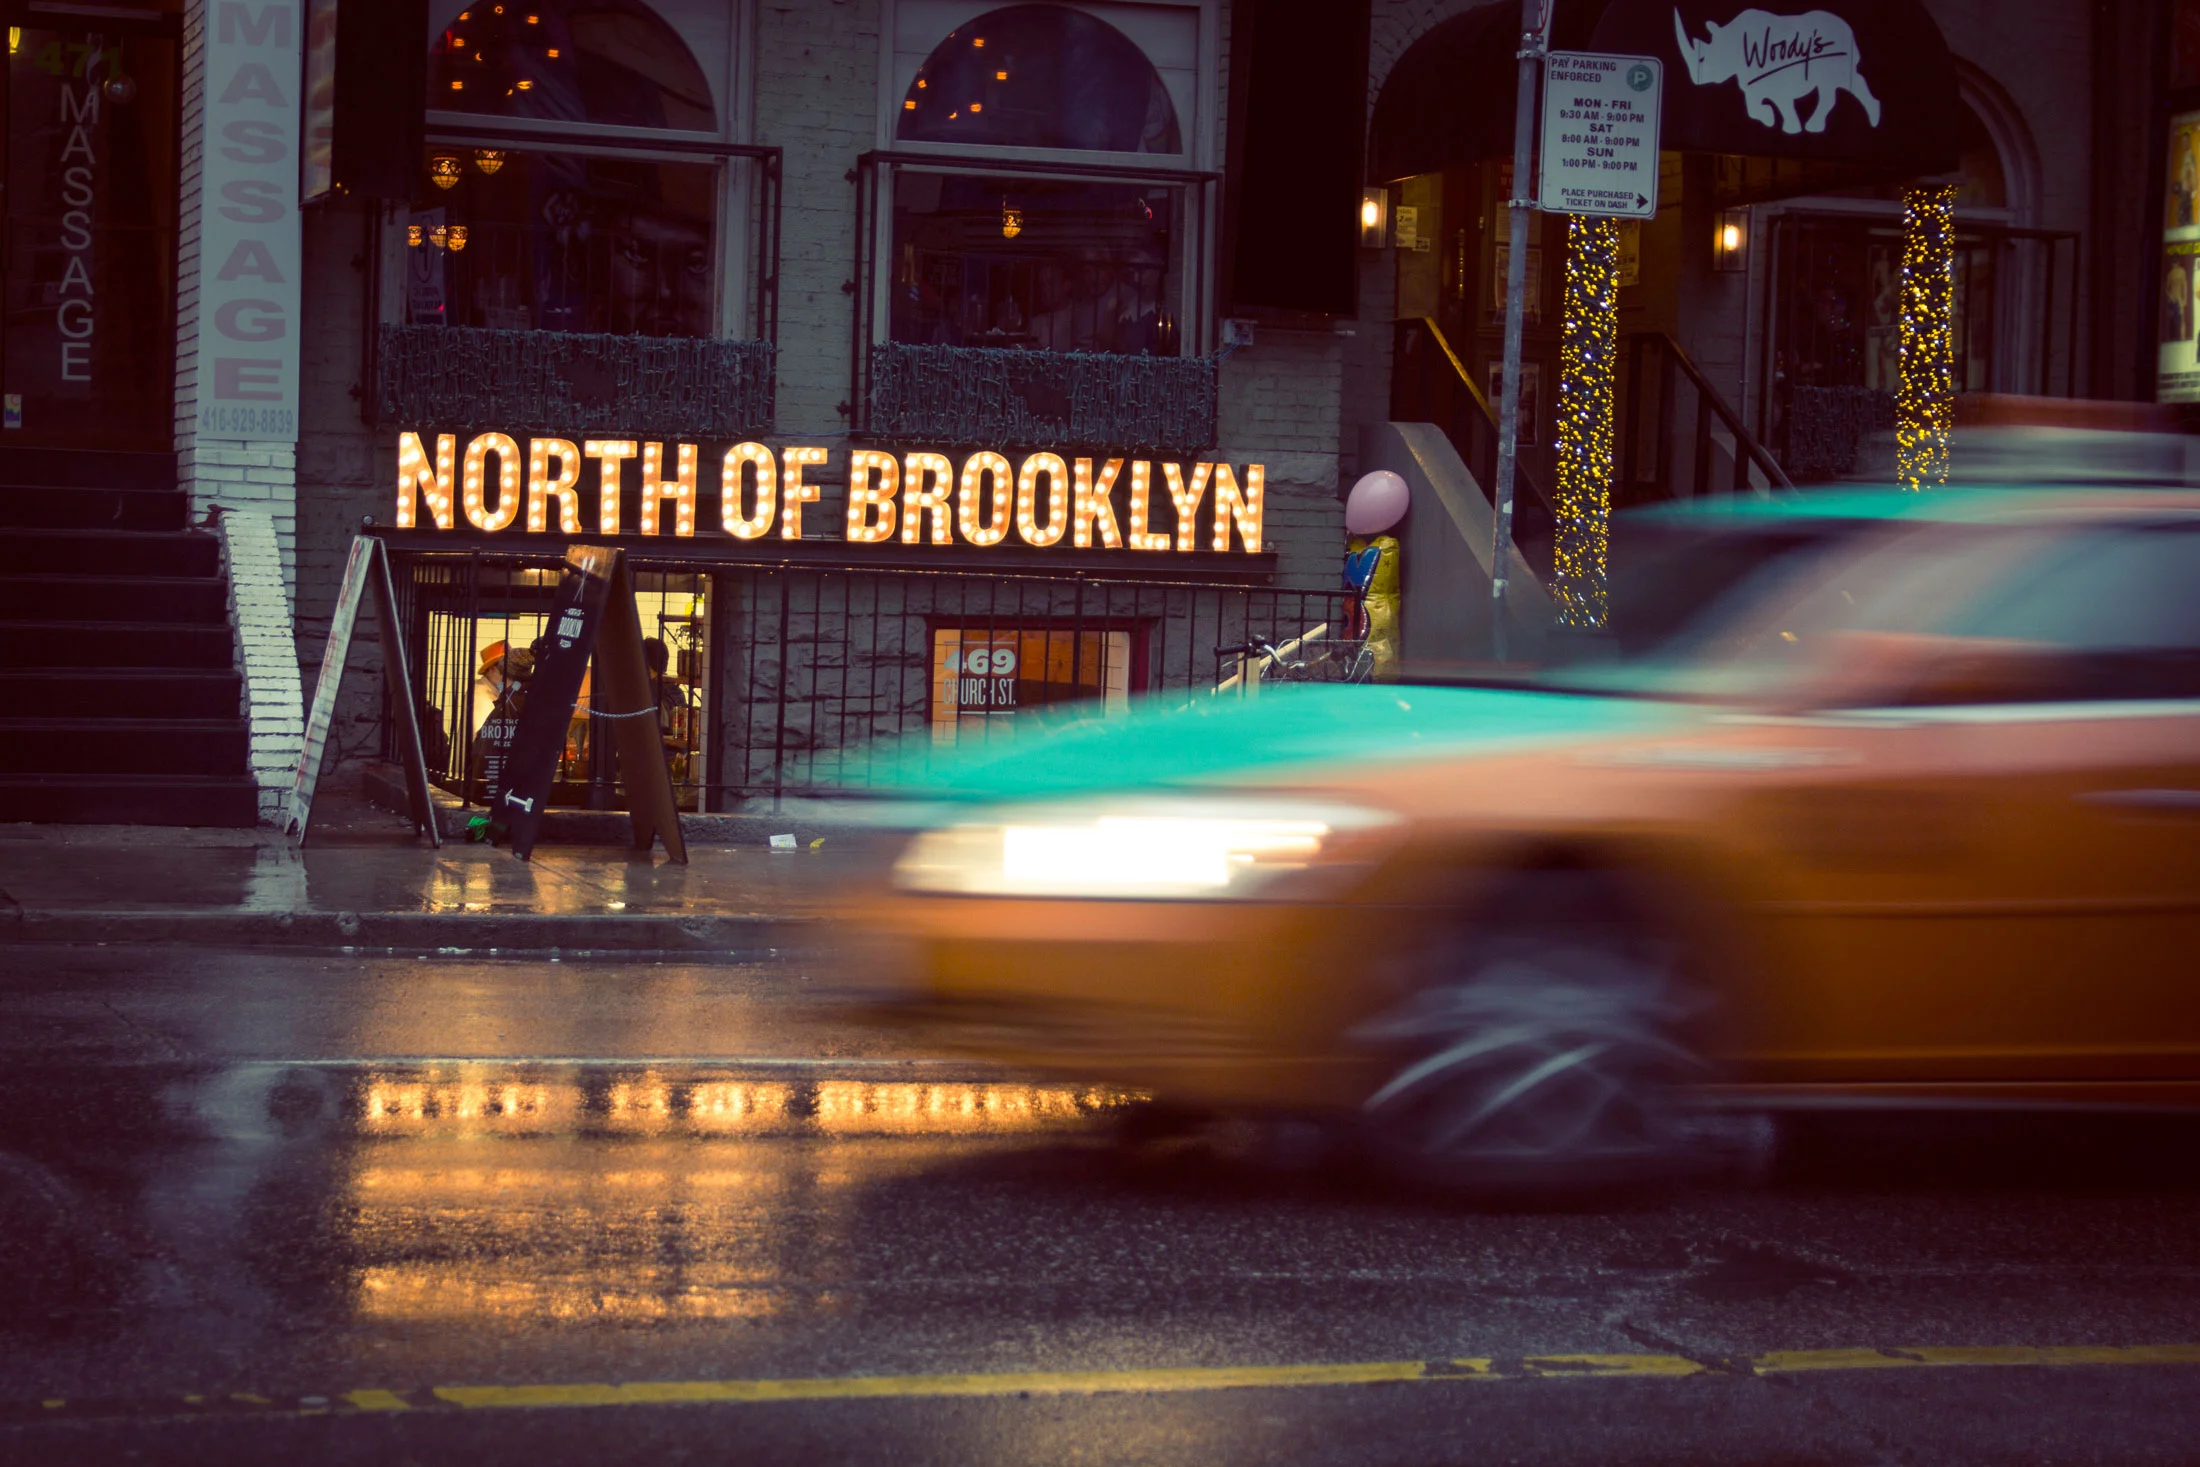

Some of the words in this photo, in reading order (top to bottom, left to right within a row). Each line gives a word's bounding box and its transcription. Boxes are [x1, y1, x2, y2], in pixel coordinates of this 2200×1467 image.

[1744, 27, 1835, 80] Woody's
[34, 41, 121, 80] 471
[1551, 58, 1570, 68] PAY
[1573, 59, 1617, 71] PARKING
[1550, 71, 1602, 82] ENFORCED
[1573, 98, 1602, 108] MON
[1611, 100, 1632, 110] FRI
[1560, 110, 1581, 119] 9:30
[1583, 110, 1599, 120] AM
[1606, 112, 1628, 122] 9:00
[1629, 113, 1645, 123] PM
[1589, 123, 1614, 133] SAT
[1561, 134, 1581, 143] 8:00
[1583, 135, 1598, 144] AM
[1604, 136, 1625, 146] 9:00
[1626, 137, 1640, 147] PM
[1587, 146, 1614, 157] SUN
[1562, 158, 1580, 167] 1:00
[1581, 159, 1596, 168] PM
[1602, 160, 1622, 170] 9:00
[1623, 161, 1638, 171] PM
[1561, 188, 1585, 197] PLACE
[1587, 189, 1634, 200] PURCHASED
[213, 3, 292, 401] MASSAGE
[1566, 198, 1592, 207] TICKET
[1594, 199, 1606, 208] ON
[1607, 200, 1628, 209] DASH
[57, 83, 98, 381] MASSAGE
[202, 406, 293, 434] 416-929-8839
[396, 431, 698, 537] NORTH
[721, 441, 828, 540] OF
[847, 449, 1265, 553] BROOKLYN
[944, 648, 1016, 675] 469
[998, 678, 1017, 705] ST.
